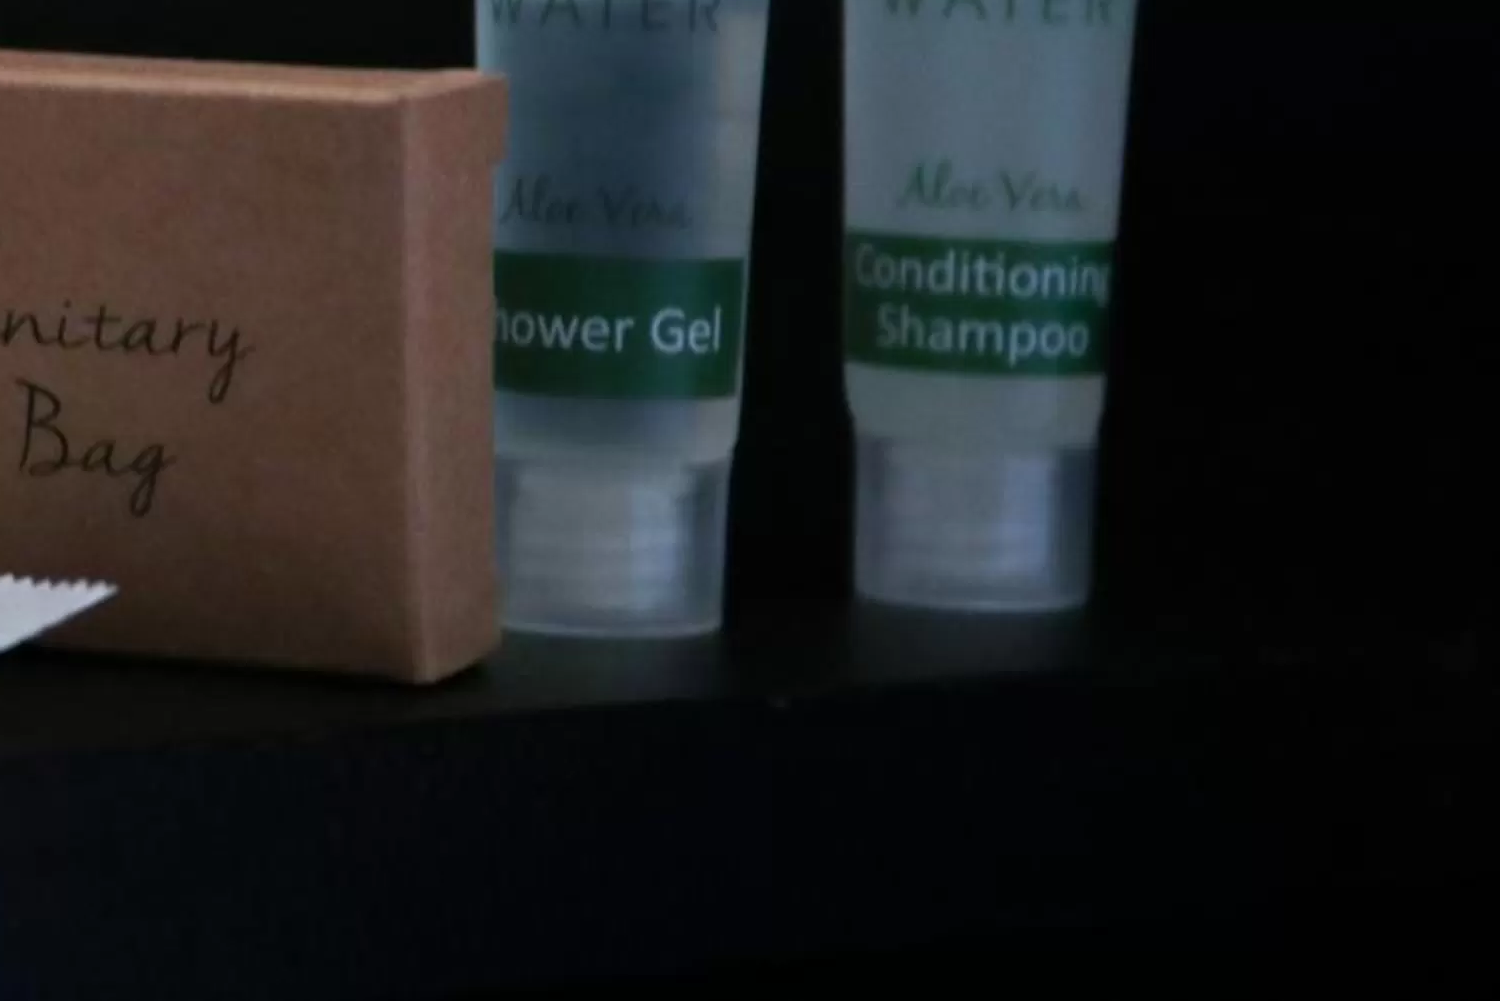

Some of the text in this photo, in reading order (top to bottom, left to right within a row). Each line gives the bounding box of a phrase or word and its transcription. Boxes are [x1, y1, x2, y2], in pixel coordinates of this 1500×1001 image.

[650, 303, 723, 356] Gel
[876, 302, 1091, 368] Shampoo
[14, 376, 180, 518] Bag
